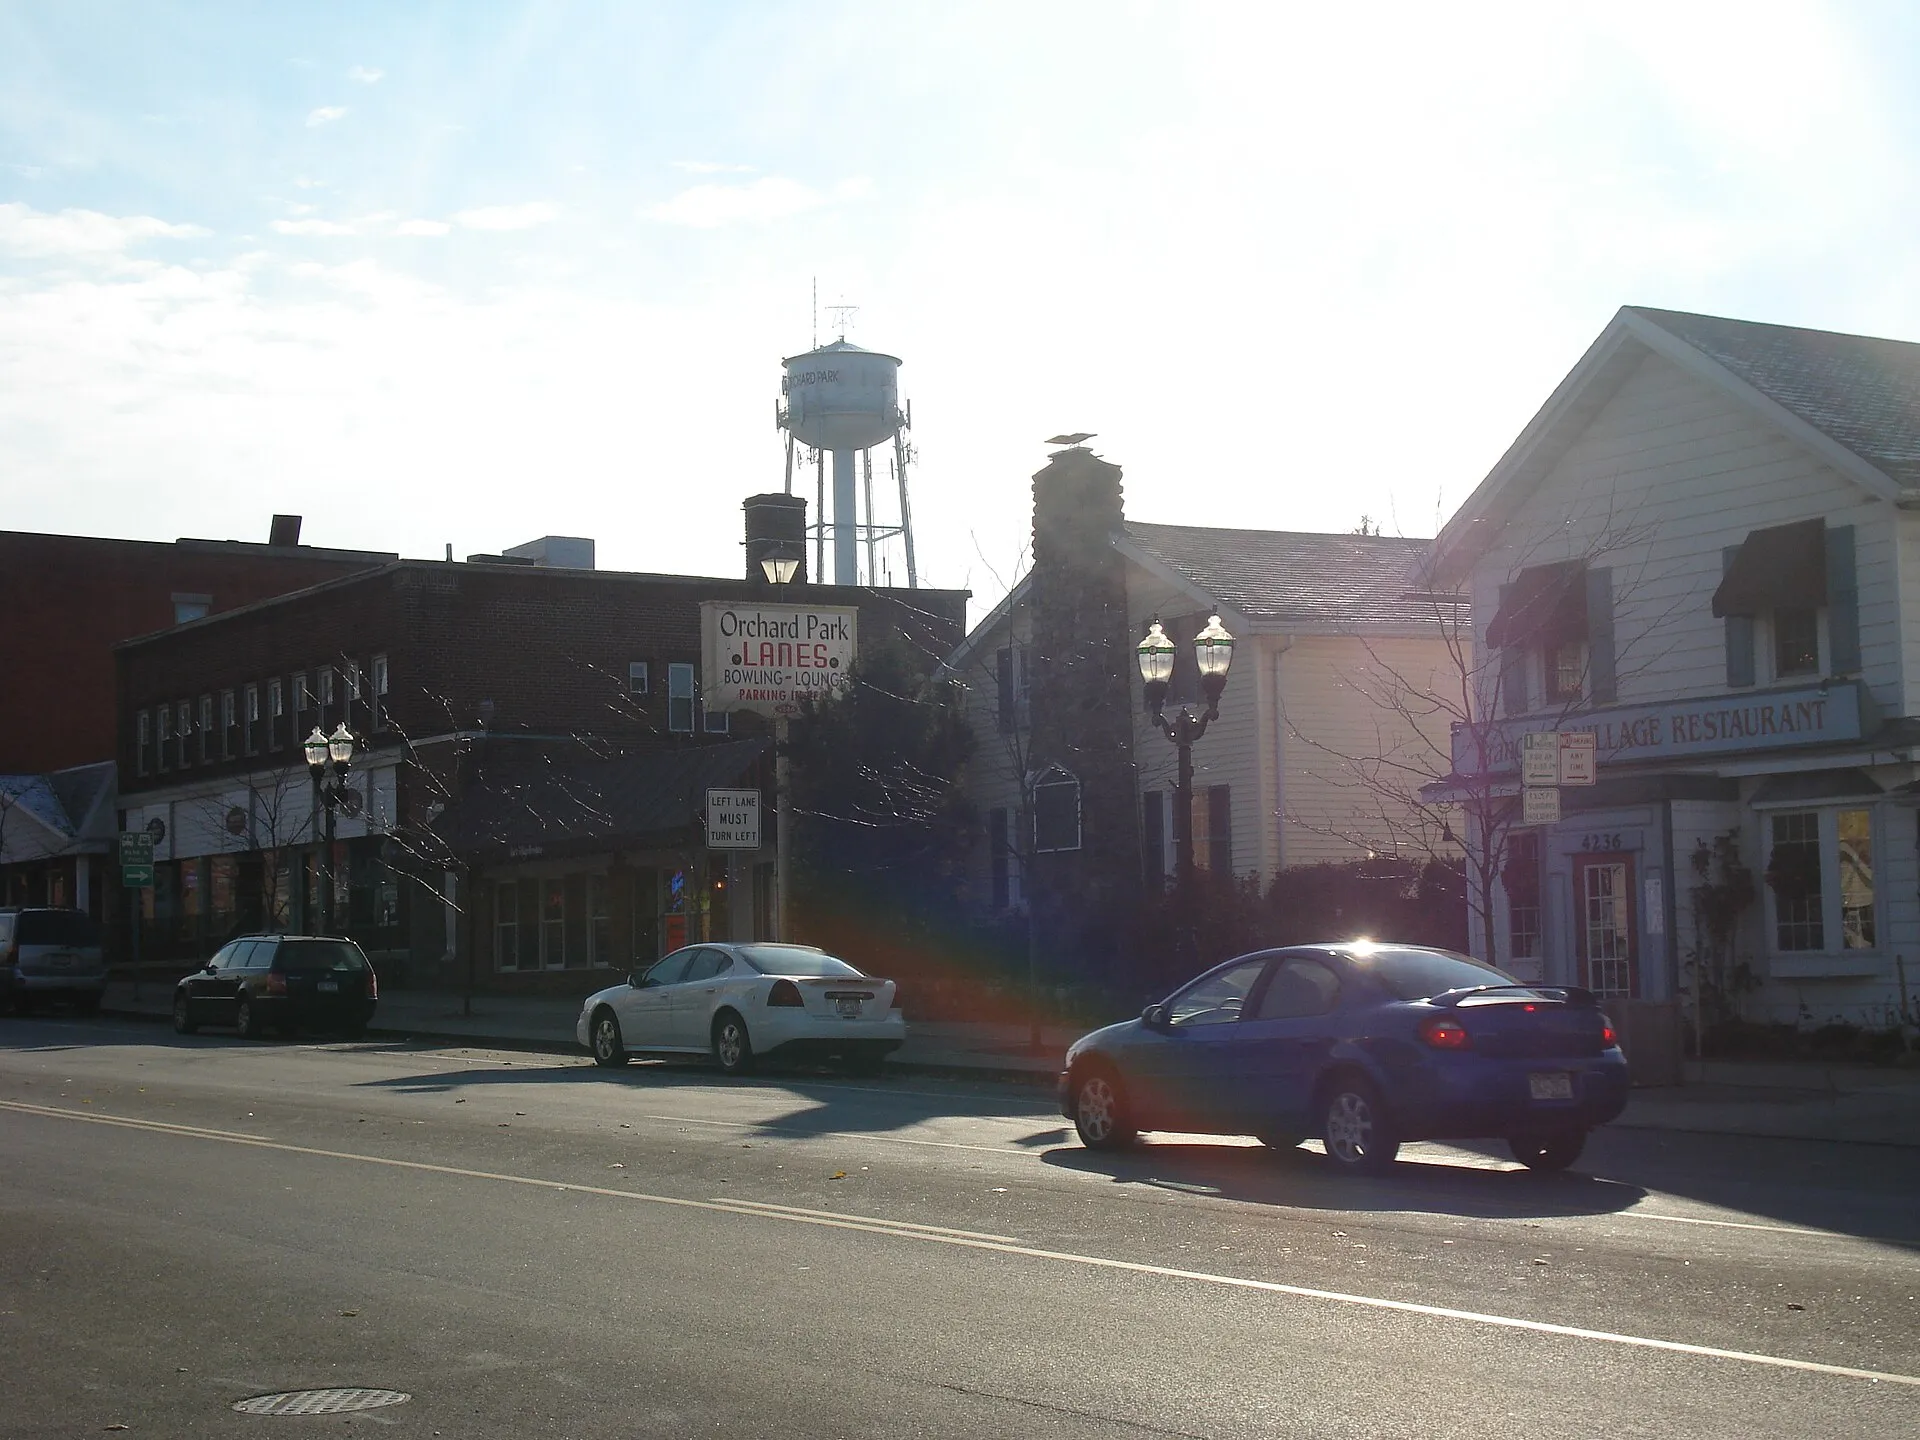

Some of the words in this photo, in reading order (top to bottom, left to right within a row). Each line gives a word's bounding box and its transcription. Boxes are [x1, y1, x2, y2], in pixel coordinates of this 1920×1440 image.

[817, 369, 839, 383] PARK
[720, 610, 799, 639] Orchard
[807, 614, 849, 640] Park
[743, 641, 828, 668] LANES
[724, 669, 783, 685] BOWLING
[739, 689, 787, 701] PARKING
[1672, 701, 1827, 743] RESTAURANT
[1570, 763, 1584, 771] TIME
[711, 797, 731, 806] LEFT
[735, 797, 756, 807] LANE
[719, 813, 748, 825] MUST
[711, 831, 732, 841] TURN
[735, 831, 756, 841] LEFT
[1581, 833, 1620, 851] 4236
